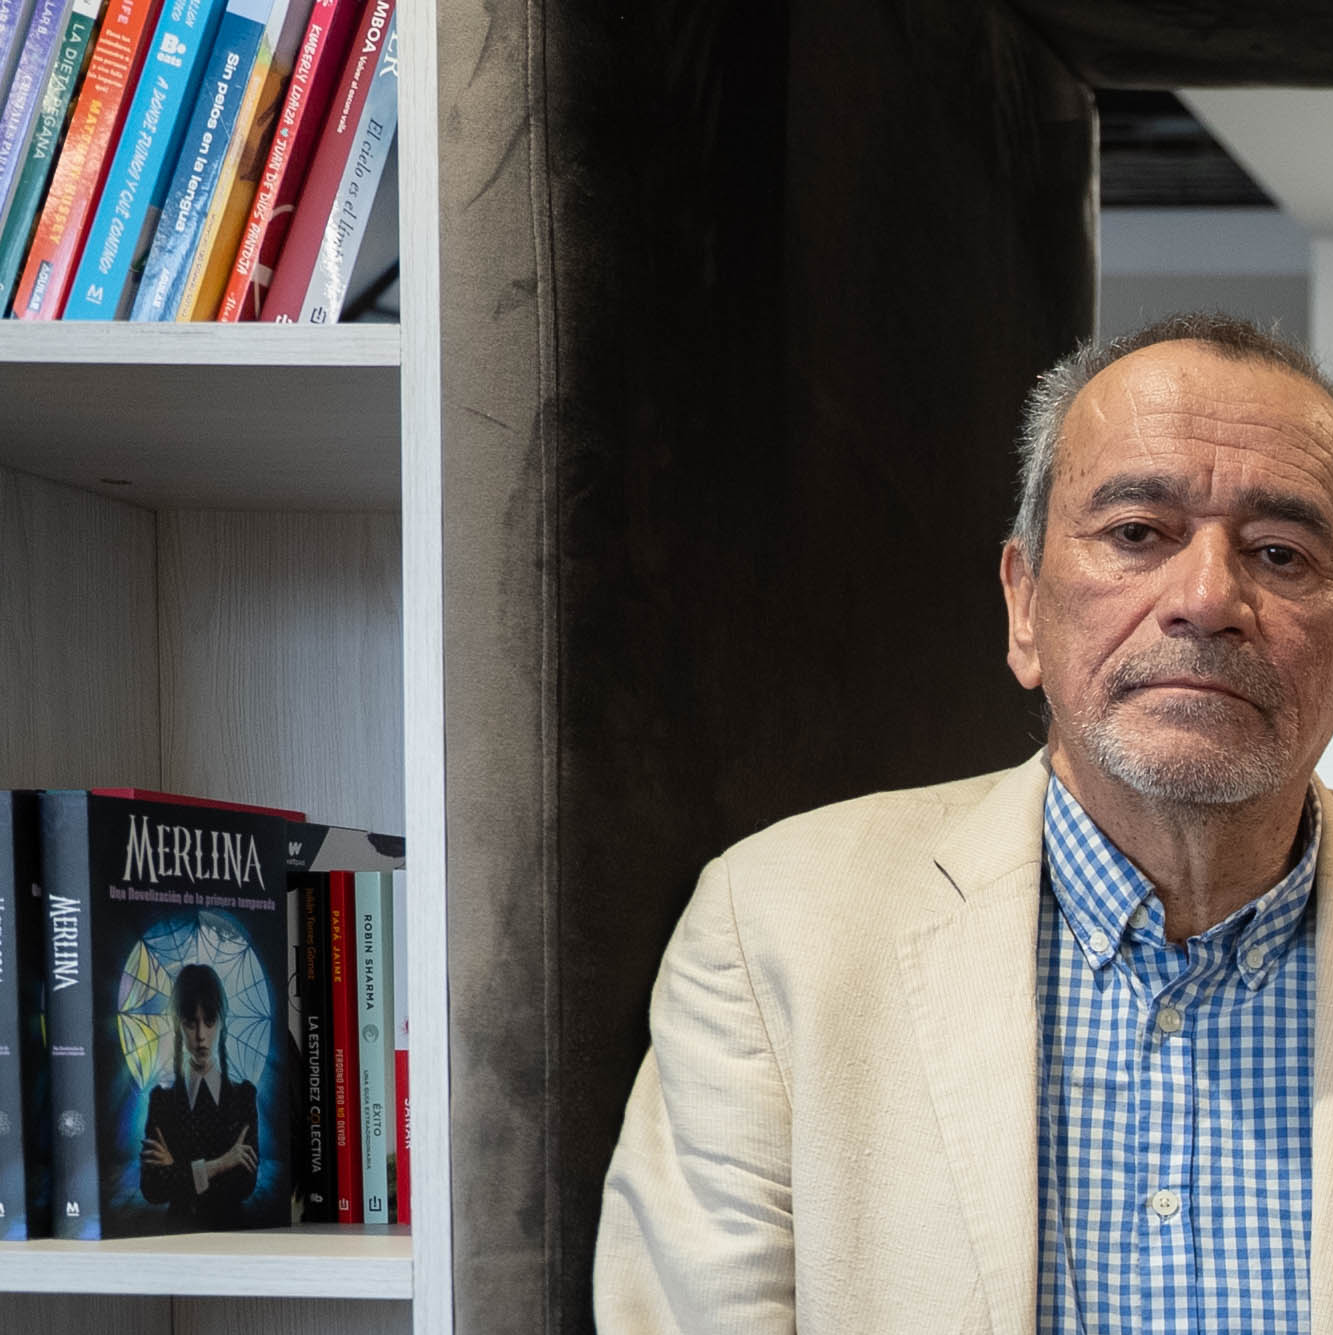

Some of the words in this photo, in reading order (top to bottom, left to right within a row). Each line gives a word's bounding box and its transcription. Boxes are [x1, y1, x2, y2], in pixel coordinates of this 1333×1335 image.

[68, 22, 87, 45] LA
[294, 24, 323, 81] KIMBERLY
[53, 47, 79, 91] DIETA
[220, 52, 240, 80] Sin
[203, 80, 232, 129] pelos
[281, 85, 303, 125] LOAIZA
[198, 131, 215, 154] en
[364, 117, 385, 139] El
[192, 156, 208, 173] la
[267, 138, 287, 171] JUAN
[352, 140, 379, 179] cielo
[170, 172, 203, 232] lengua
[251, 190, 271, 220] DIOS
[234, 222, 261, 274] PANTOJA
[122, 815, 266, 892] MERLINA
[109, 885, 126, 900] Una
[205, 895, 236, 908] primera
[49, 894, 81, 992] MERLINA
[331, 910, 343, 941] PAPÁ
[363, 914, 374, 954] ROBIN
[332, 946, 343, 983] JAIME
[364, 958, 376, 1010] SHARMA
[308, 1015, 318, 1031] LA
[308, 1034, 320, 1101] ESTUPIDEZ
[337, 1120, 346, 1147] OLVIDO
[371, 1103, 383, 1137] ÉXITO
[309, 1106, 321, 1173] COLECTIVA
